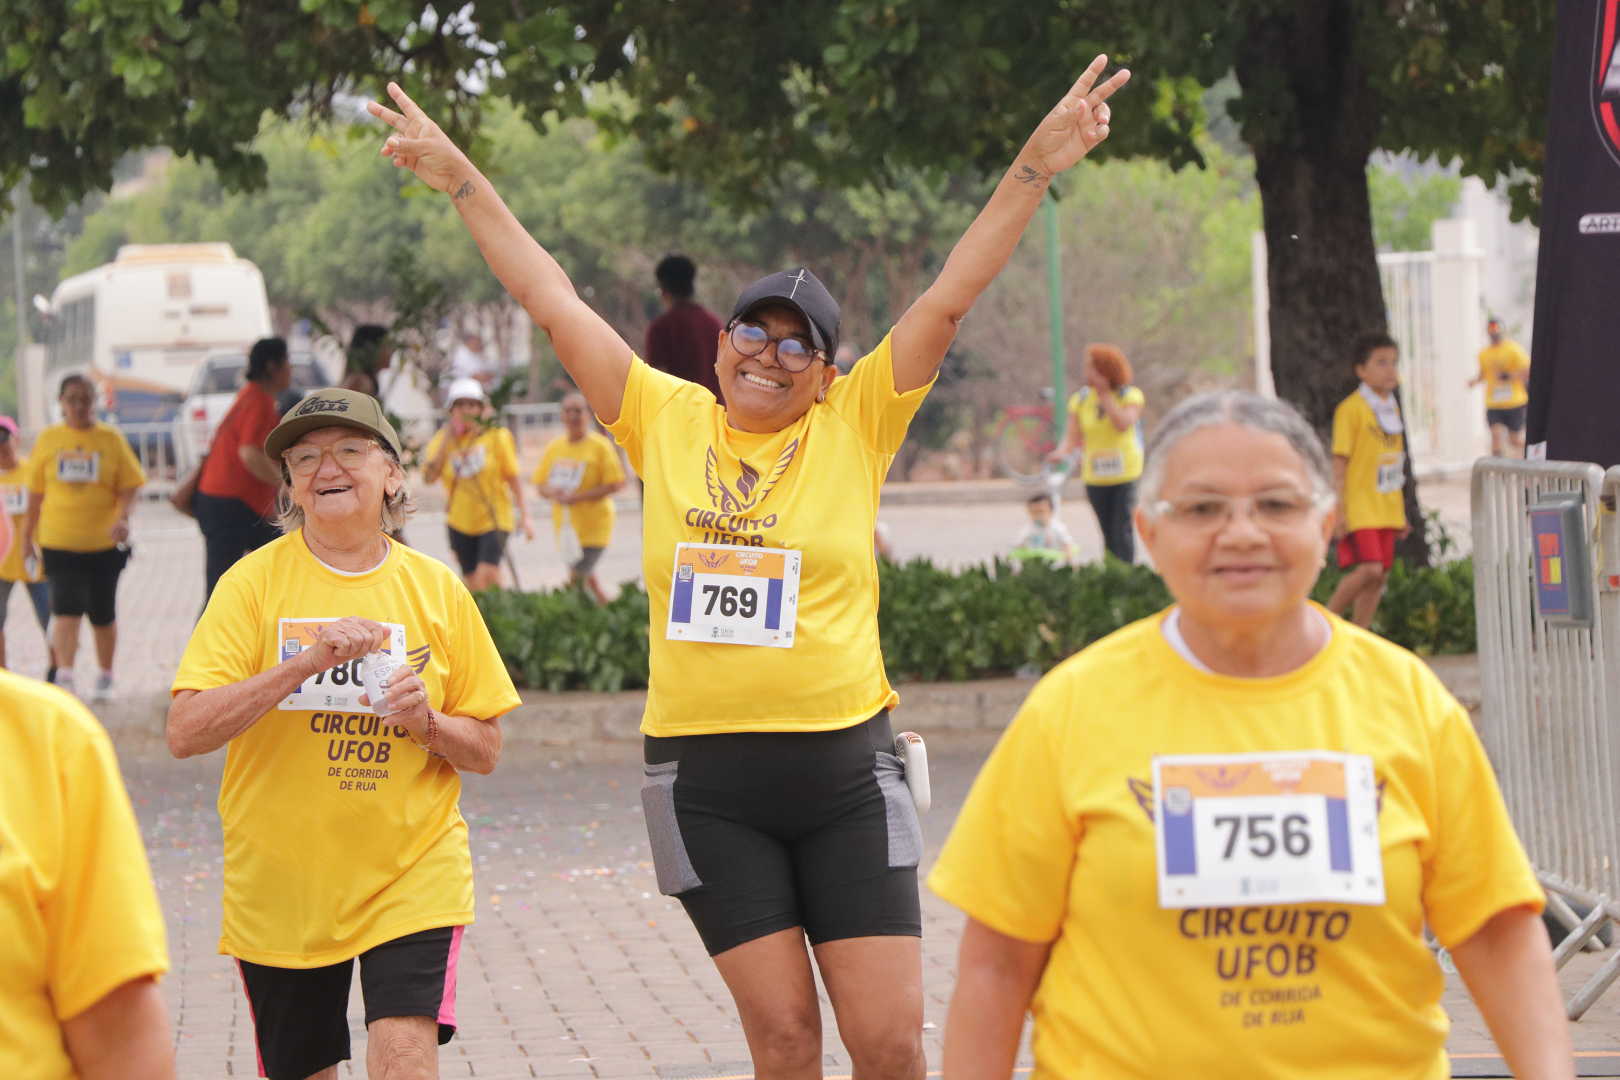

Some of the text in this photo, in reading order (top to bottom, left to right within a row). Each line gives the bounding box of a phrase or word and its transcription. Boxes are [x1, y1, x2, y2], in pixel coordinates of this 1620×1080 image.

[685, 507, 778, 532] CIRCUITO
[735, 551, 764, 559] CIRCUITO
[740, 558, 758, 566] UFOB
[702, 585, 758, 618] 769
[327, 739, 391, 763] UFOB
[328, 767, 389, 779] DE CORRIDA
[340, 781, 377, 791] DE RUA
[1213, 813, 1312, 861] 756
[1179, 907, 1352, 942] CIRCUITO
[1217, 943, 1317, 981] UFOB
